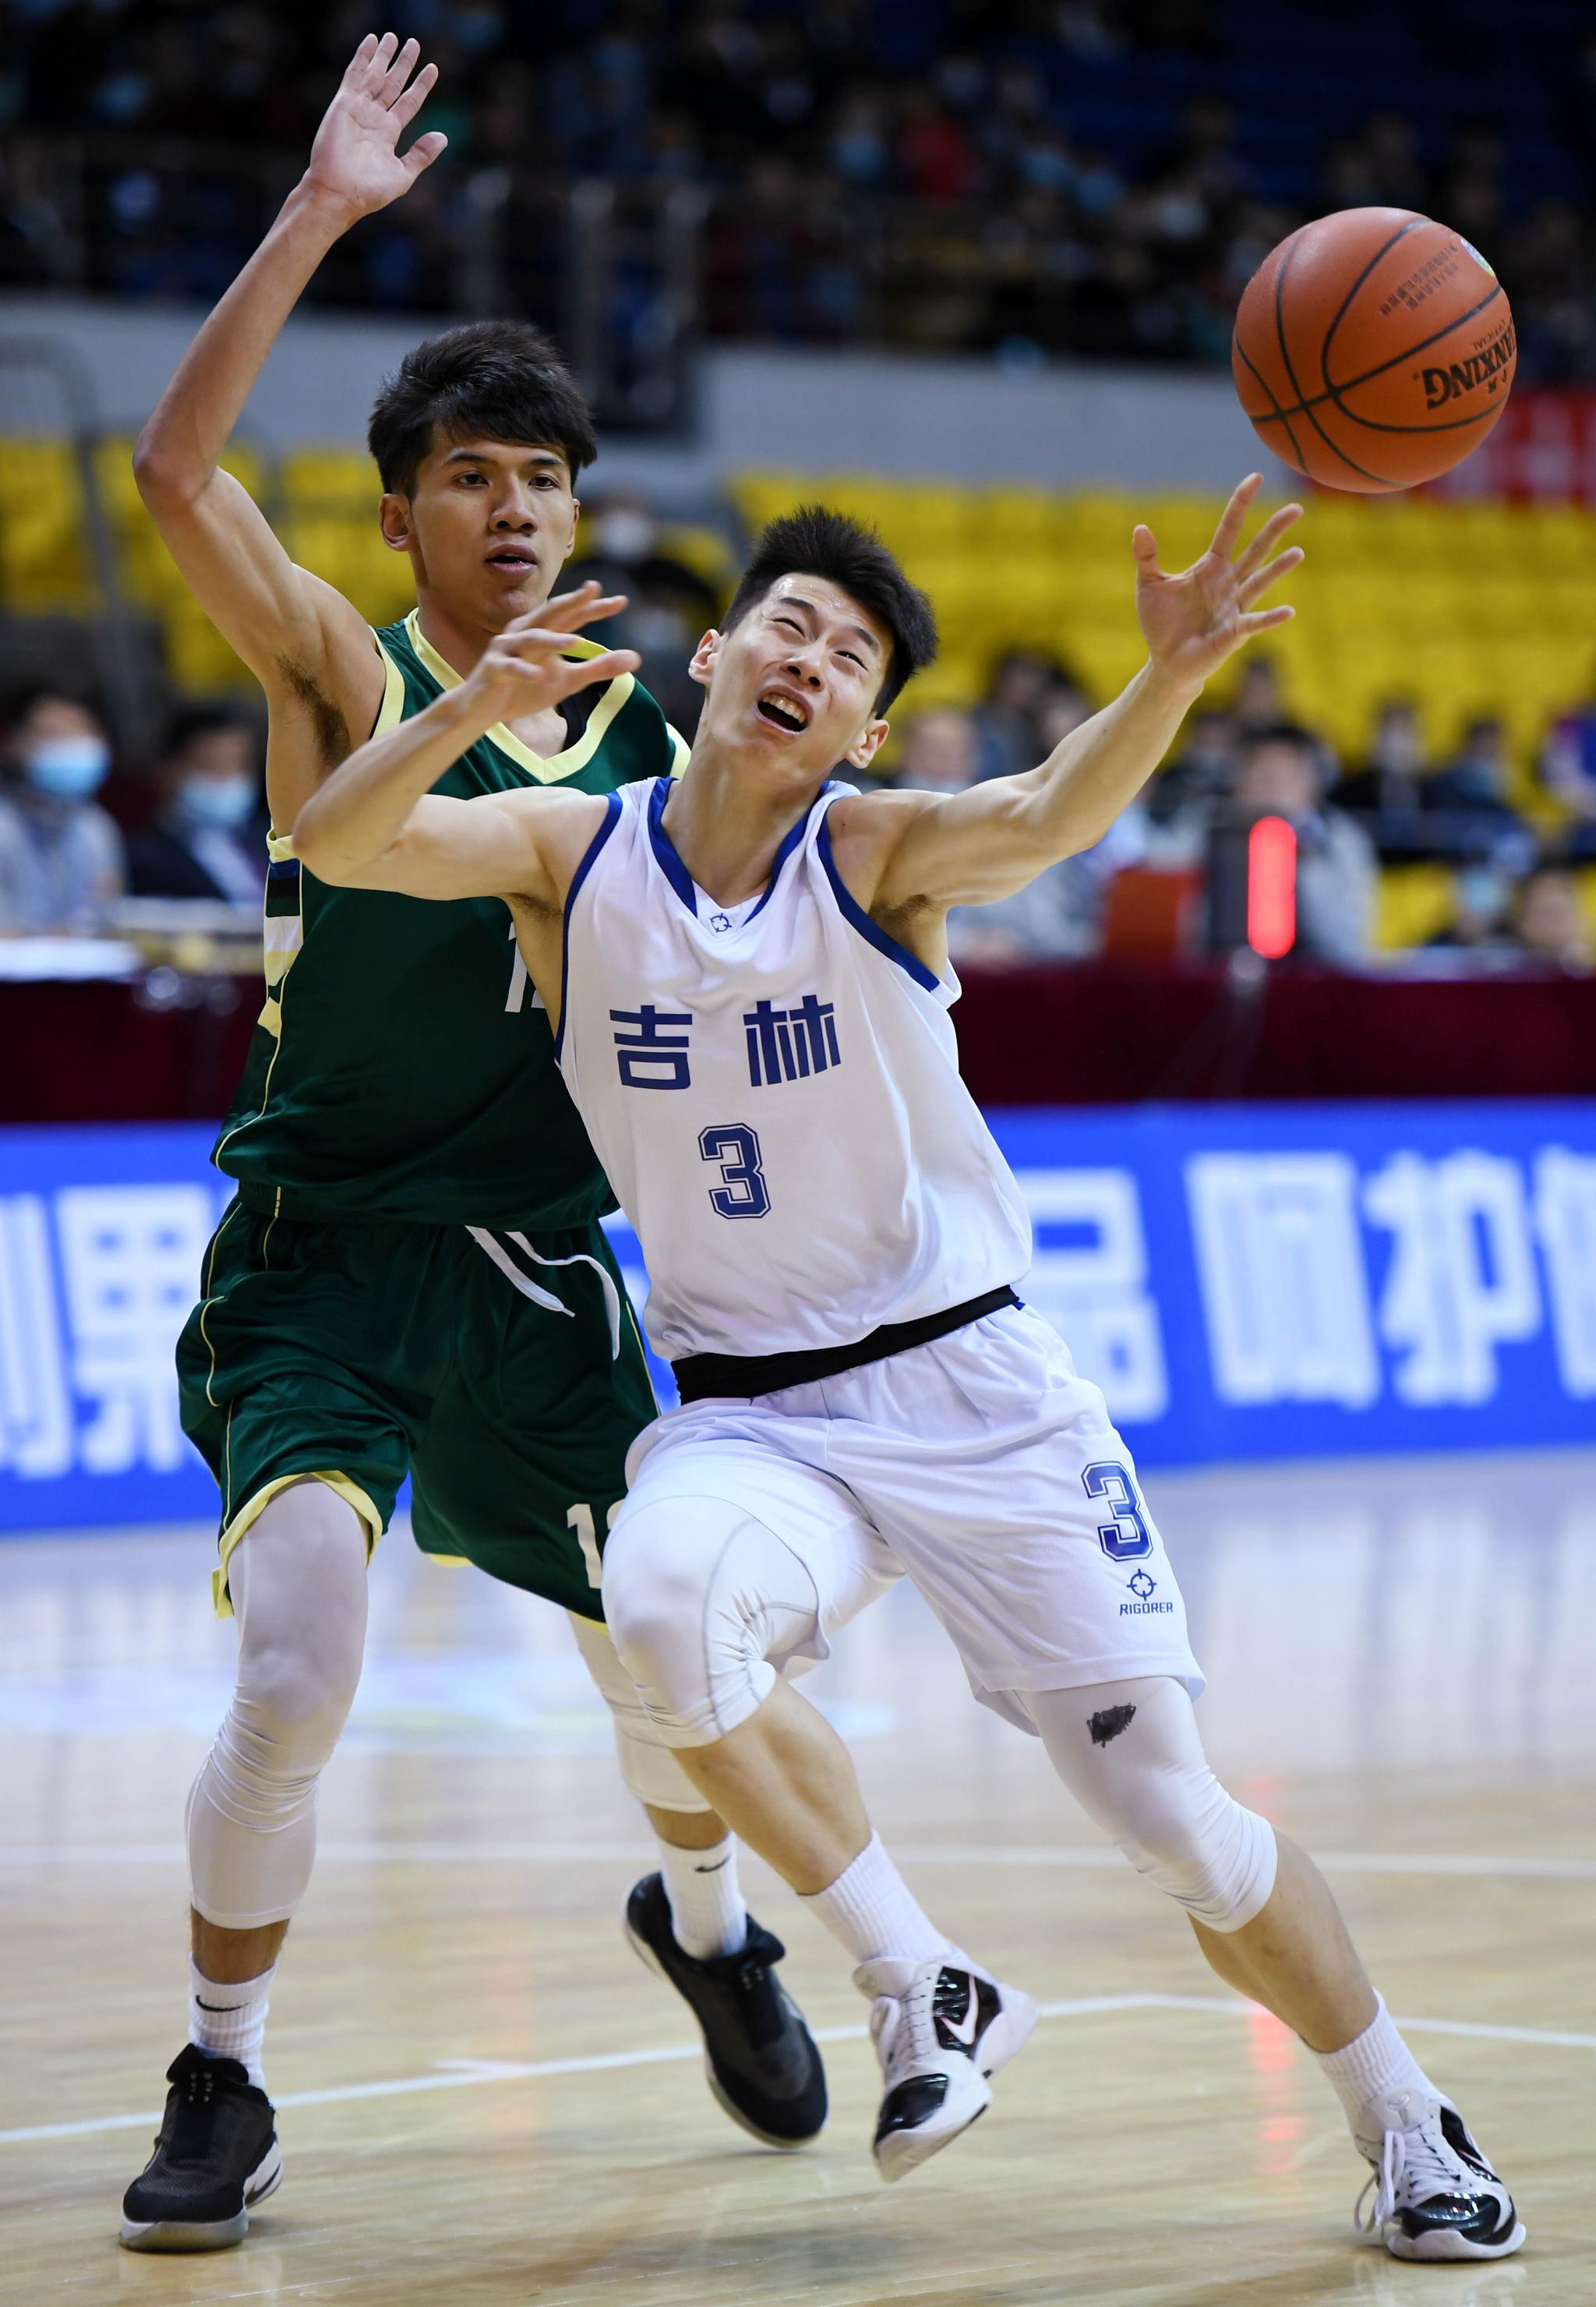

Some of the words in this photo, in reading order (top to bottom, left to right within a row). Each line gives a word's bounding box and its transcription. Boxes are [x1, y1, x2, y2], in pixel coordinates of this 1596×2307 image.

[609, 994, 842, 1090] 吉林
[697, 1122, 772, 1219] 3
[567, 1498, 626, 1590] 1
[1081, 1461, 1154, 1562] 3
[1119, 1602, 1174, 1616] RIGORER
